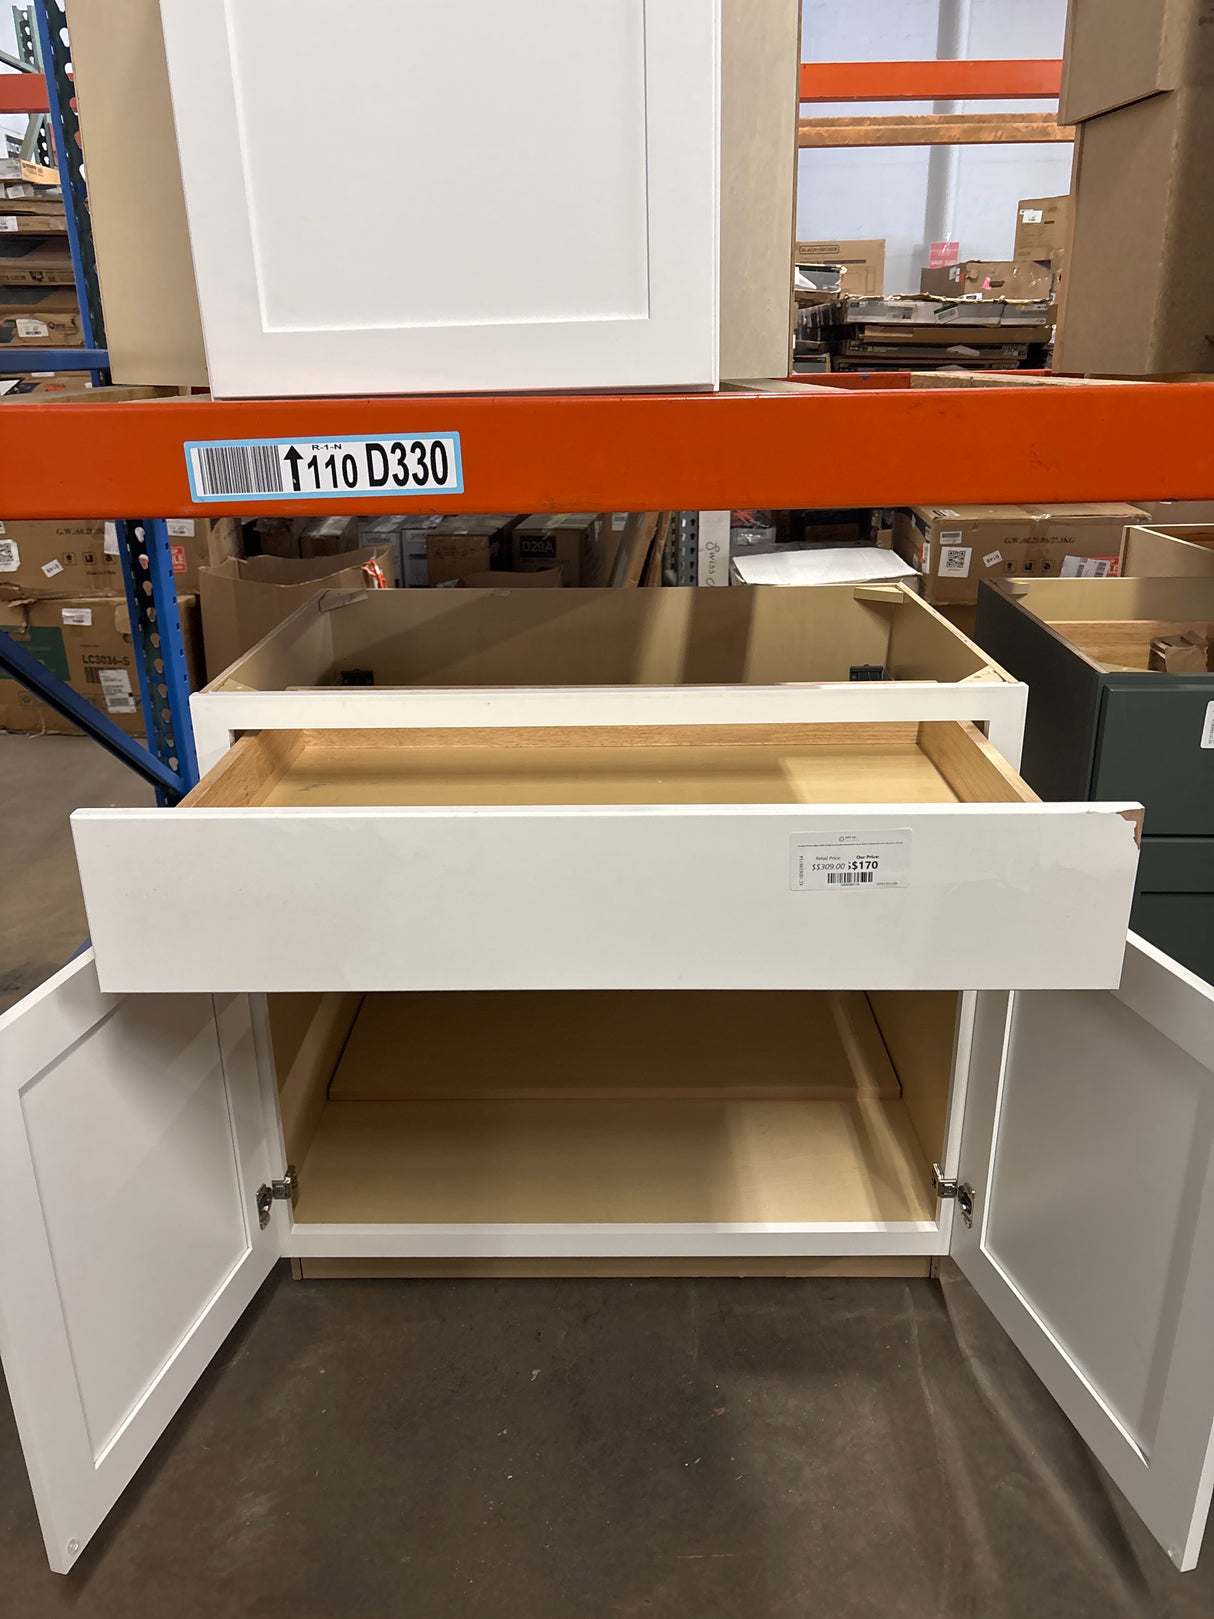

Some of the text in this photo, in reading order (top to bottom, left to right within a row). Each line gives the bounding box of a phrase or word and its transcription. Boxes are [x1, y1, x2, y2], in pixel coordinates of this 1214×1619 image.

[311, 443, 342, 451] R-1-N
[307, 440, 448, 489] 110 D330
